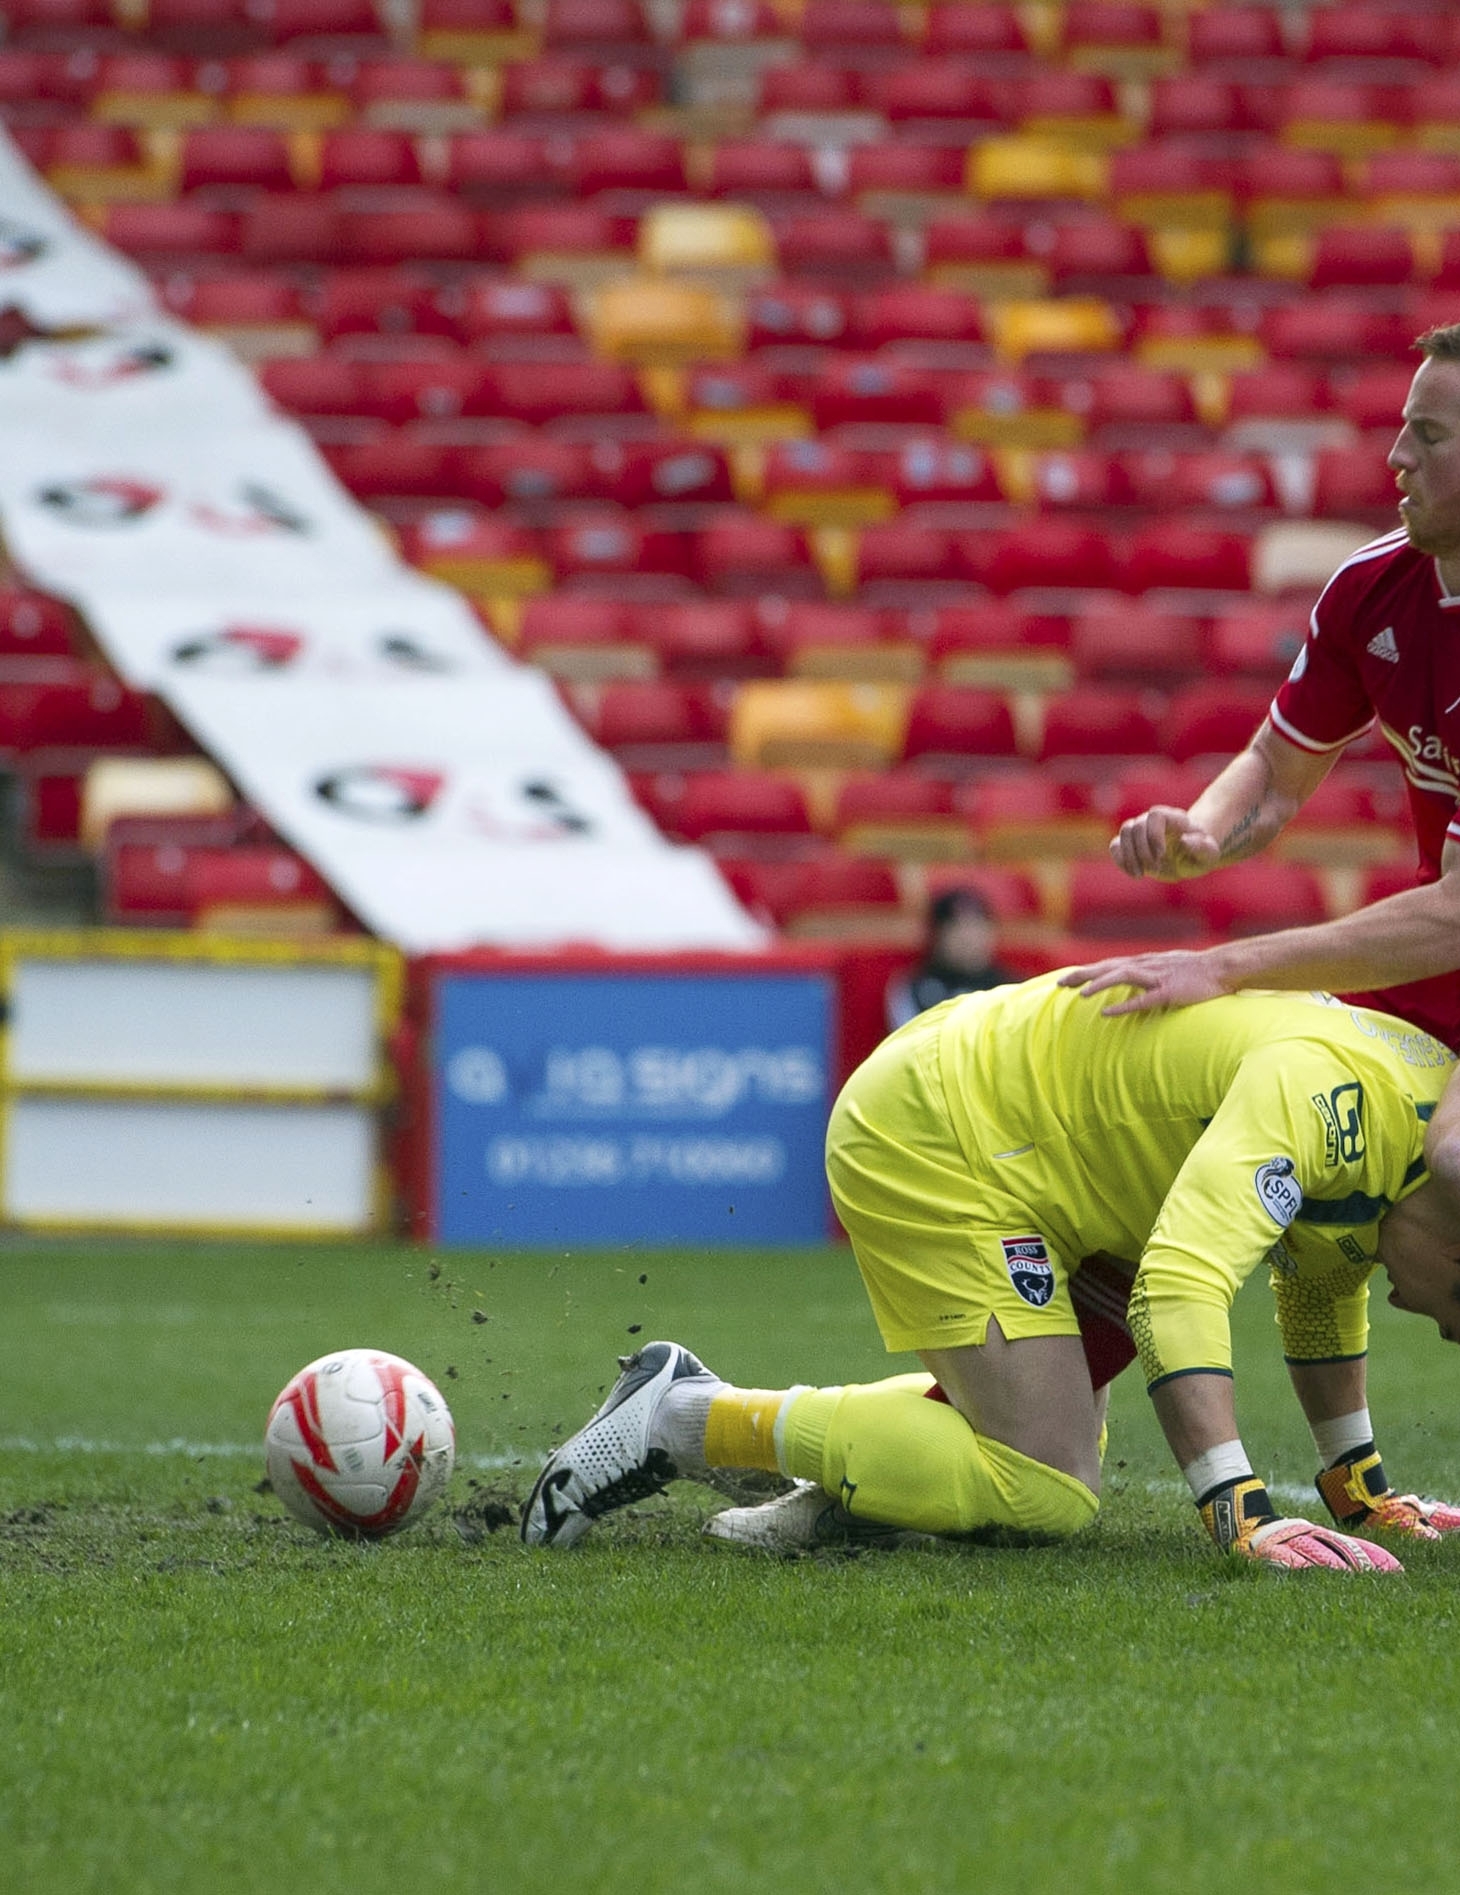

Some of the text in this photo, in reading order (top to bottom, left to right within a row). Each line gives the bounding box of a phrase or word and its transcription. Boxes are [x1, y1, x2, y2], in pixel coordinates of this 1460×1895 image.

[1271, 1180, 1298, 1219] SPFL
[1015, 1246, 1038, 1256] ROSS
[1010, 1261, 1051, 1274] COUNTY
